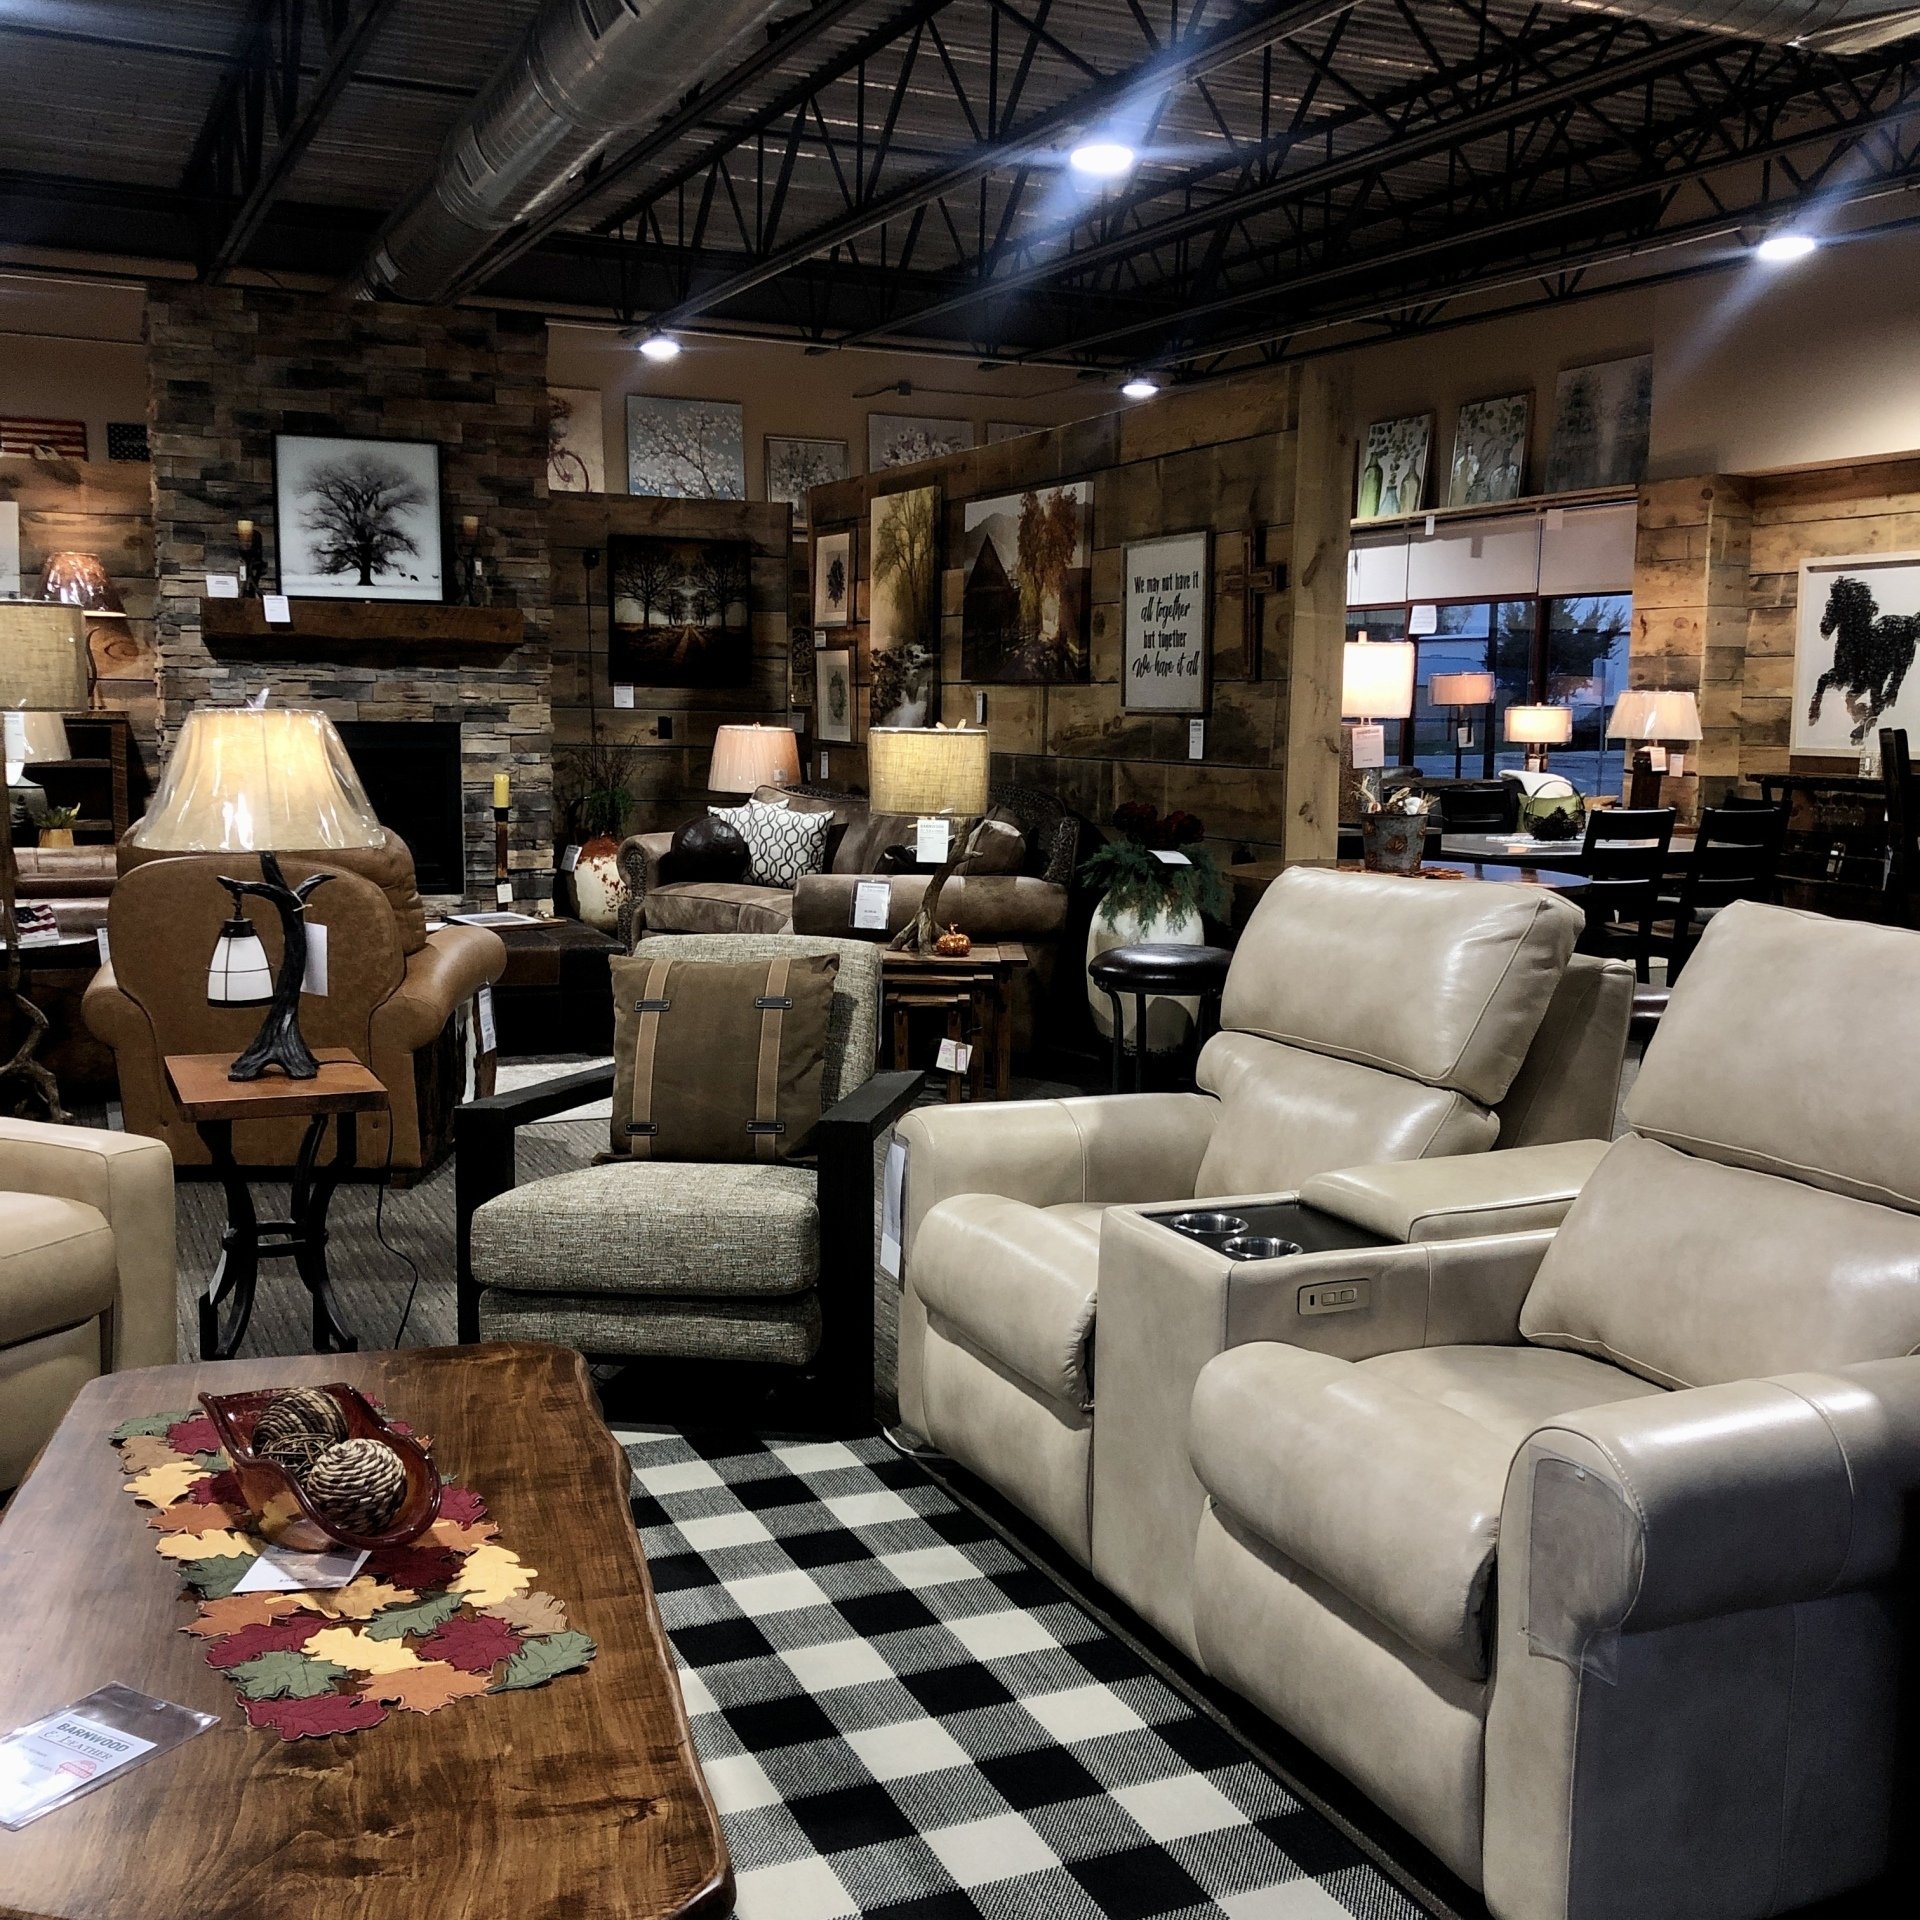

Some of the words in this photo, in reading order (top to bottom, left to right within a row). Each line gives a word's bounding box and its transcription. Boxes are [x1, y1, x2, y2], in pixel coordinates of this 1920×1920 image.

[1134, 576, 1144, 593] We
[1147, 577, 1159, 594] may
[1162, 573, 1172, 591] not
[1175, 572, 1190, 590] have
[1193, 571, 1199, 588] it
[1141, 597, 1154, 622] all
[1156, 593, 1190, 629] together
[1143, 630, 1155, 648] but
[1158, 629, 1187, 651] together
[1132, 653, 1151, 678] We
[1154, 651, 1174, 677] have
[1177, 652, 1186, 677] it
[1186, 651, 1200, 676] all
[57, 1722, 130, 1752] BARNWOOD
[58, 1735, 113, 1760] LEATHER
